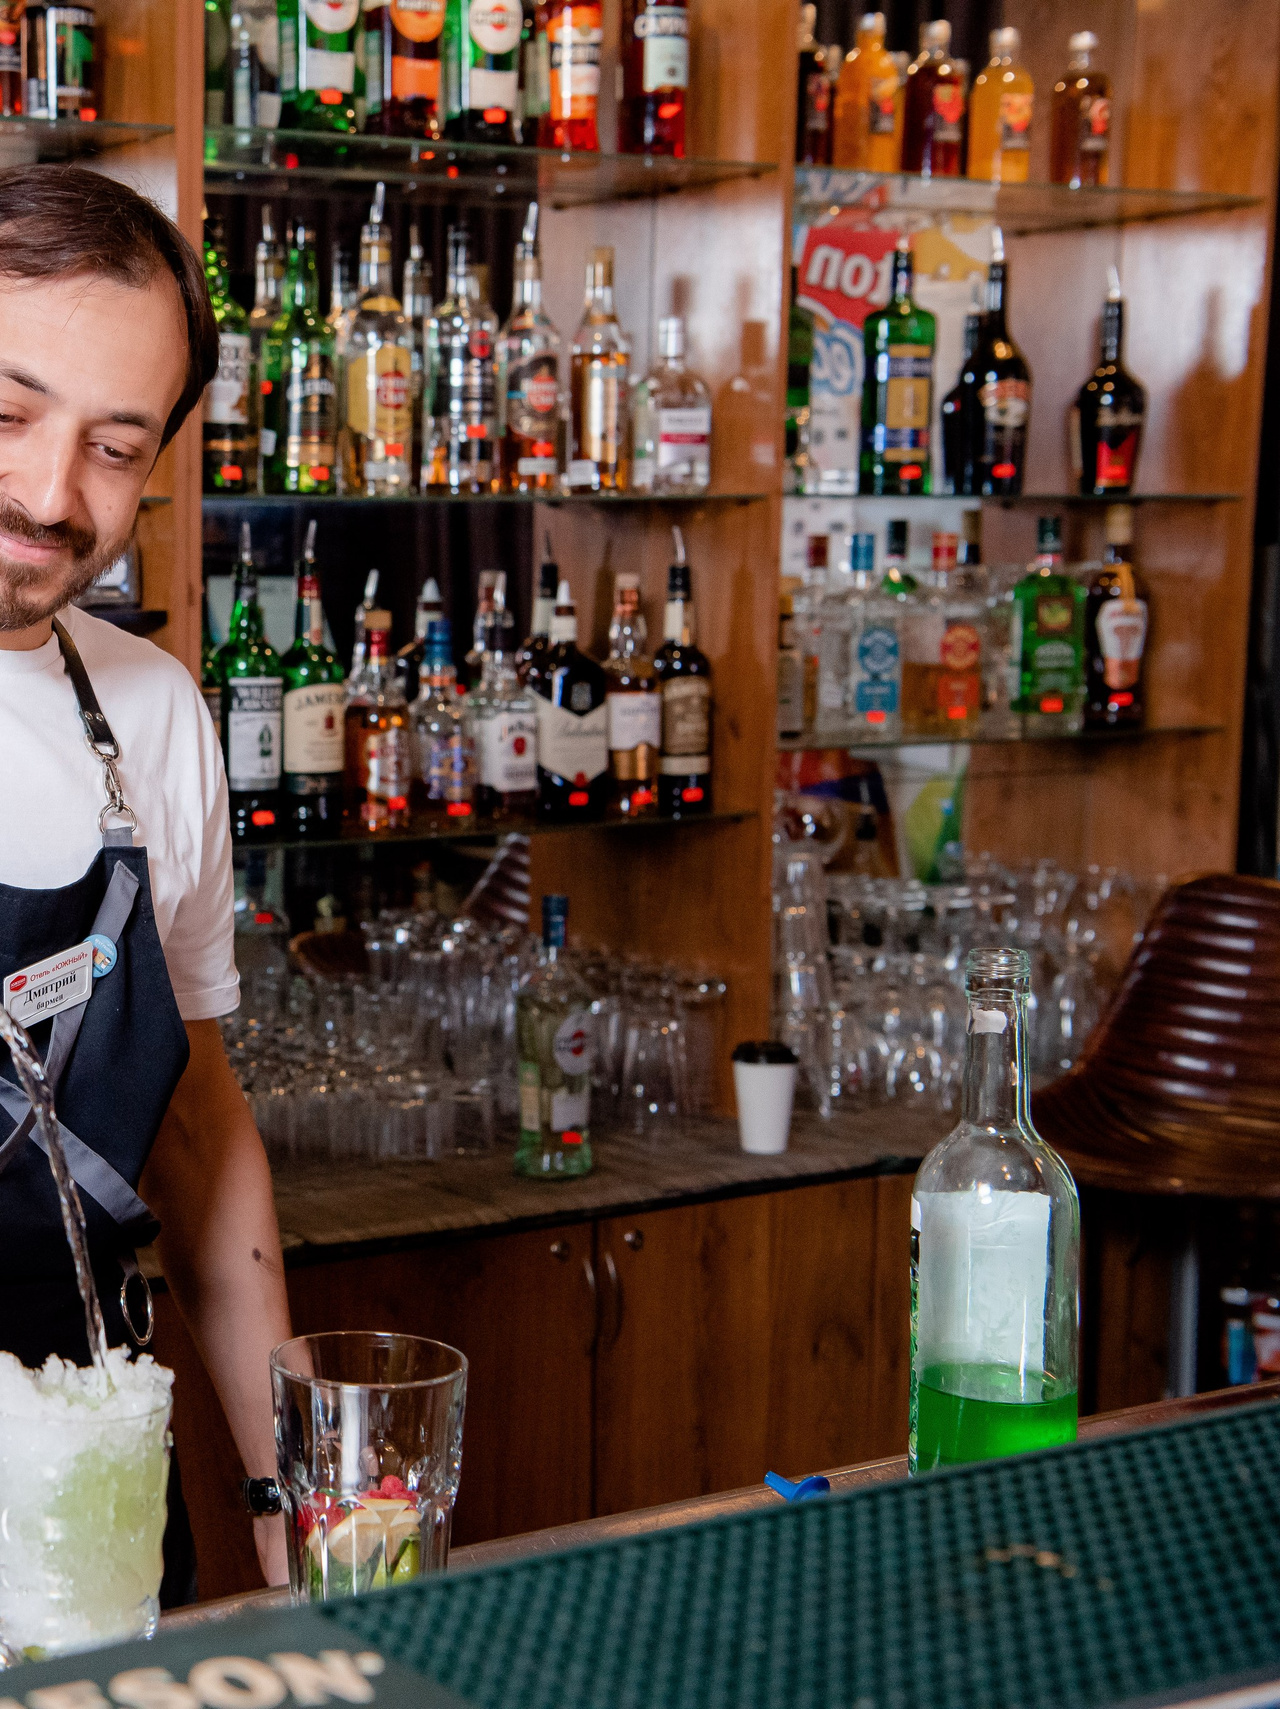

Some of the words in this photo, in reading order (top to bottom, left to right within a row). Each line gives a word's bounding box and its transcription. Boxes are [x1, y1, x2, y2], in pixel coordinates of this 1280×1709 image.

[30, 970, 51, 982] Отель
[23, 970, 77, 1006] Дмитрий
[36, 994, 64, 1010] бармен
